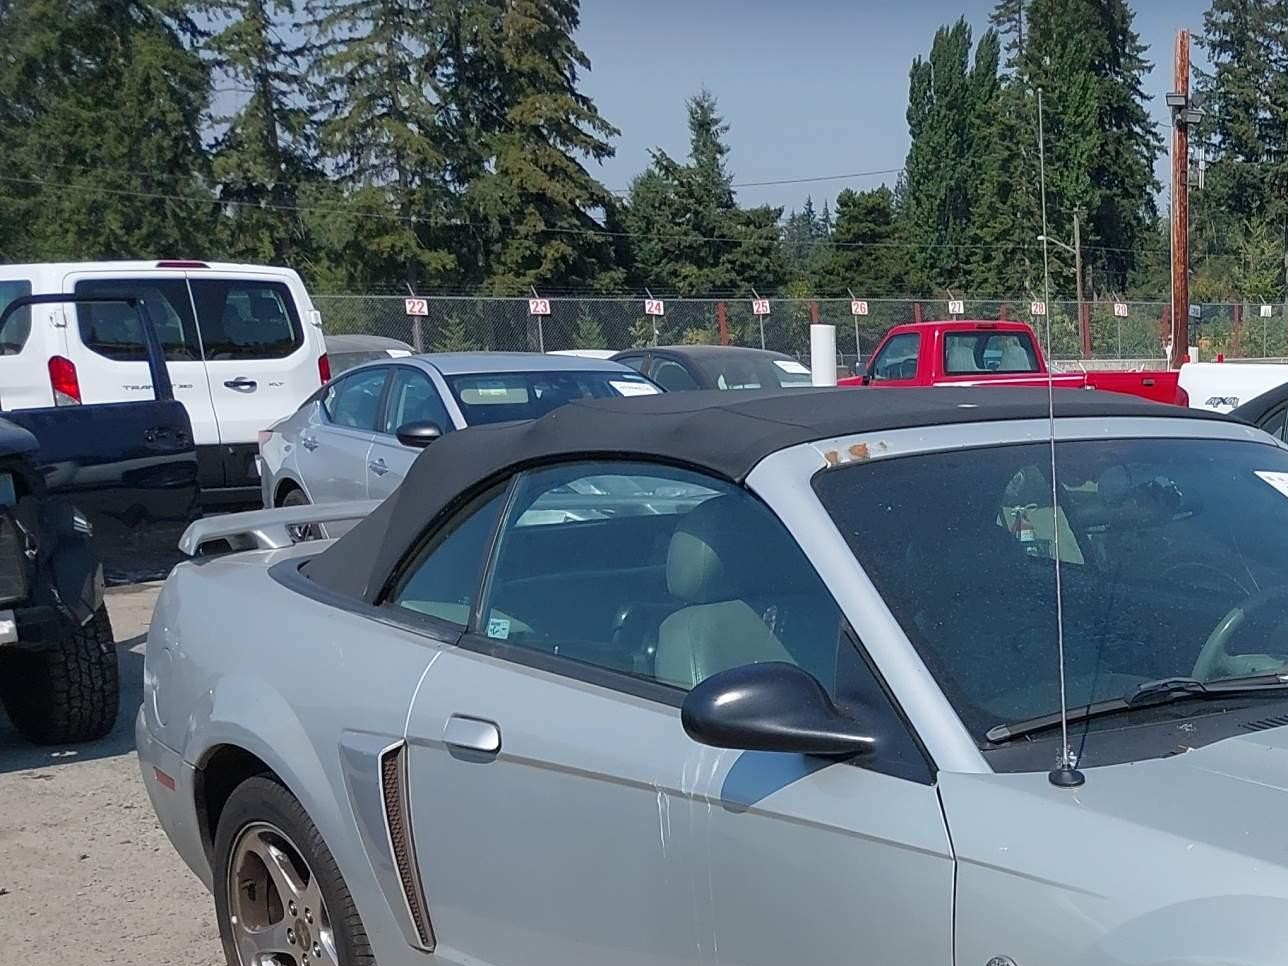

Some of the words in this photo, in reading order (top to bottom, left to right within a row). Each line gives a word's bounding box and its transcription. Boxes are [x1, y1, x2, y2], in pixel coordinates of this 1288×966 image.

[407, 300, 425, 314] 22
[531, 300, 548, 313] 23
[647, 301, 661, 313] 24
[754, 301, 768, 313] 25
[853, 302, 866, 314] 26
[950, 302, 962, 313] 27
